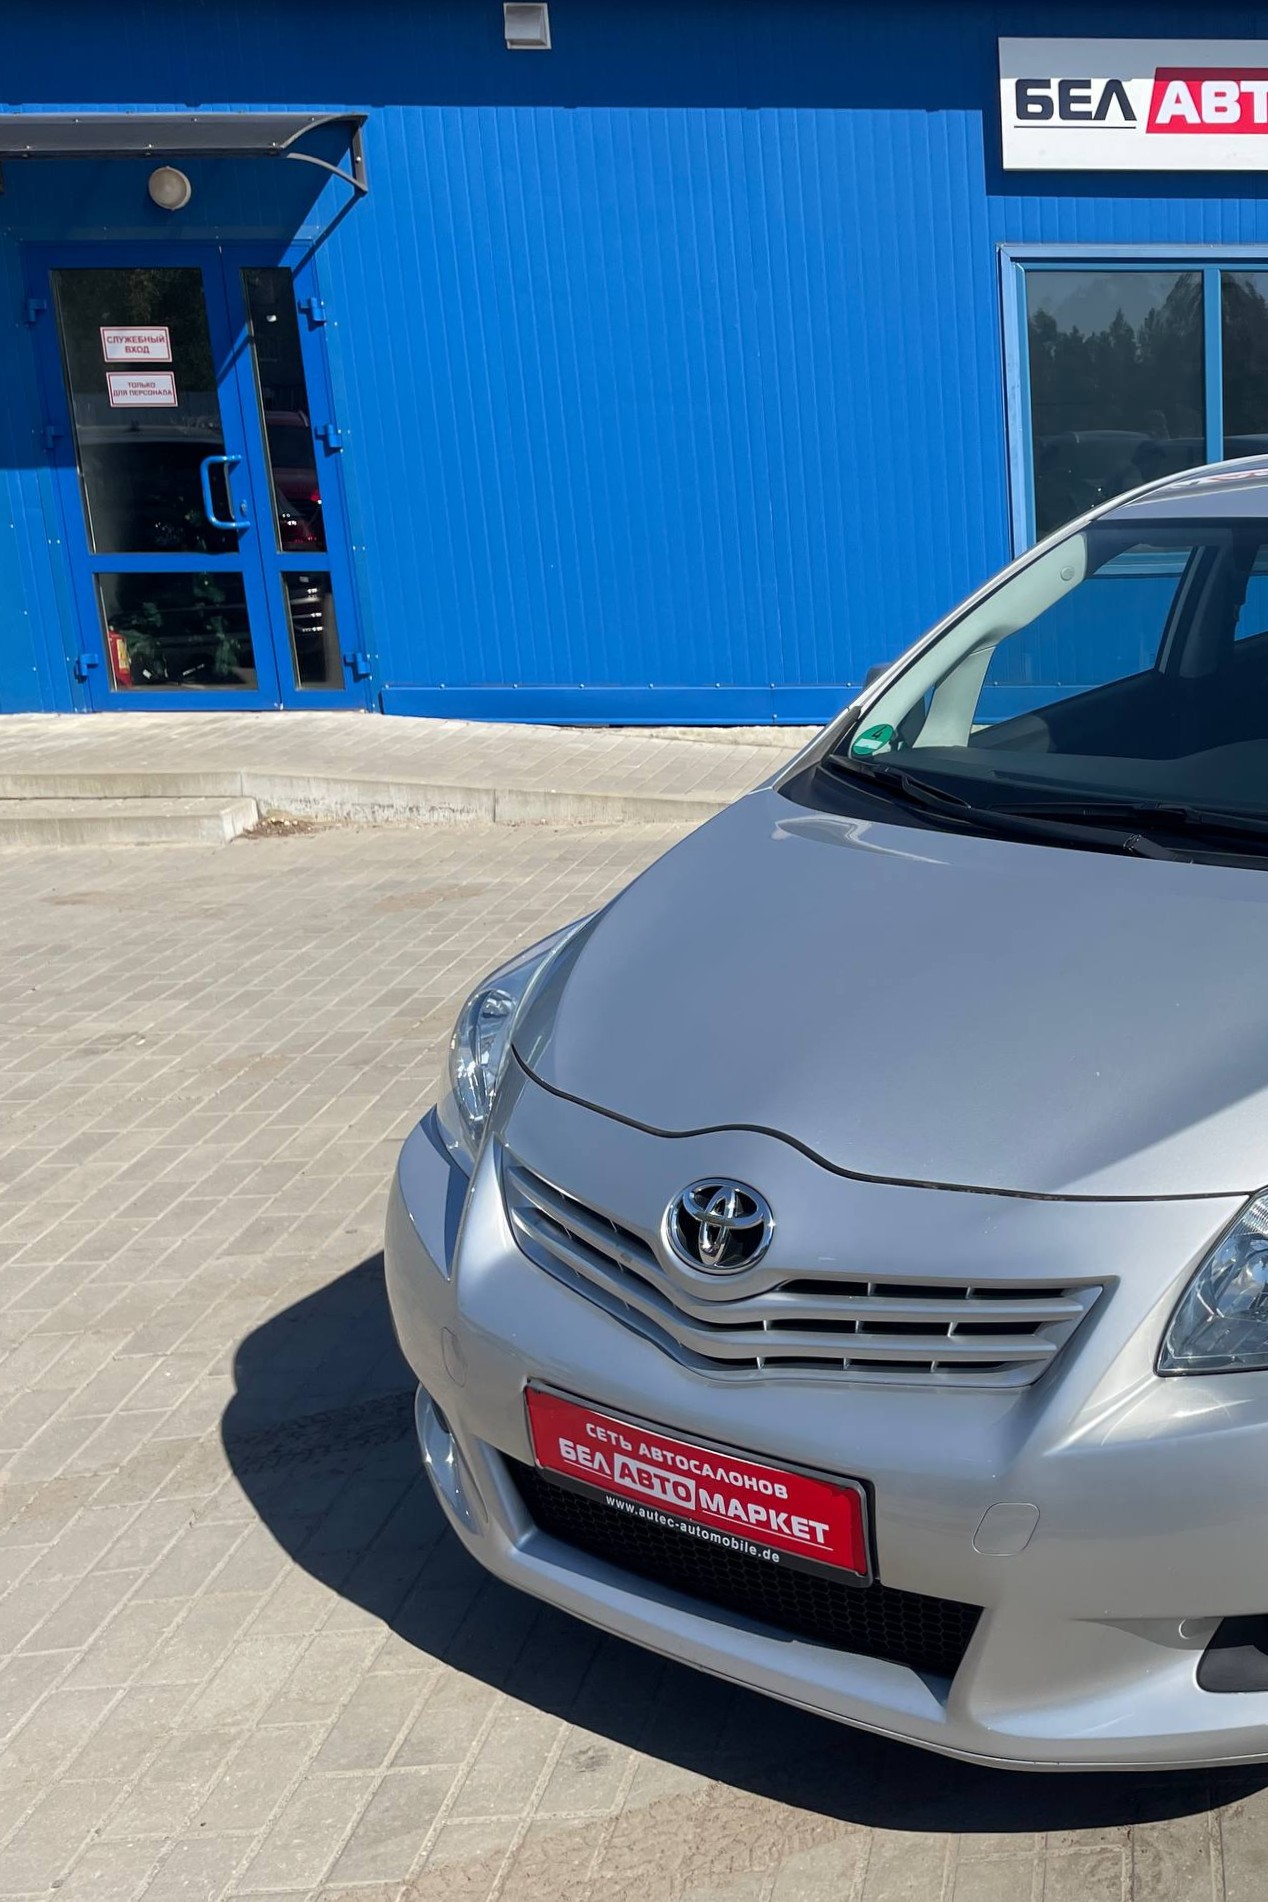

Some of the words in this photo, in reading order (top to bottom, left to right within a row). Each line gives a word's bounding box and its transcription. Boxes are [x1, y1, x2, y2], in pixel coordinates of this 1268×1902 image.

[1015, 78, 1136, 122] БЕЛ
[106, 334, 166, 344] СЛУЖЕБНЫЙ
[124, 345, 150, 354] ВХОД
[113, 389, 128, 397] ДЛЯ
[586, 1423, 632, 1451] СЕТЬ
[638, 1443, 788, 1499] АВТОСАЛОНОВ
[558, 1437, 612, 1475] БЕЛ
[618, 1459, 692, 1501] АВТО
[698, 1488, 830, 1544] МАРКЕТ
[605, 1493, 780, 1563] www.autec-automobile.de
